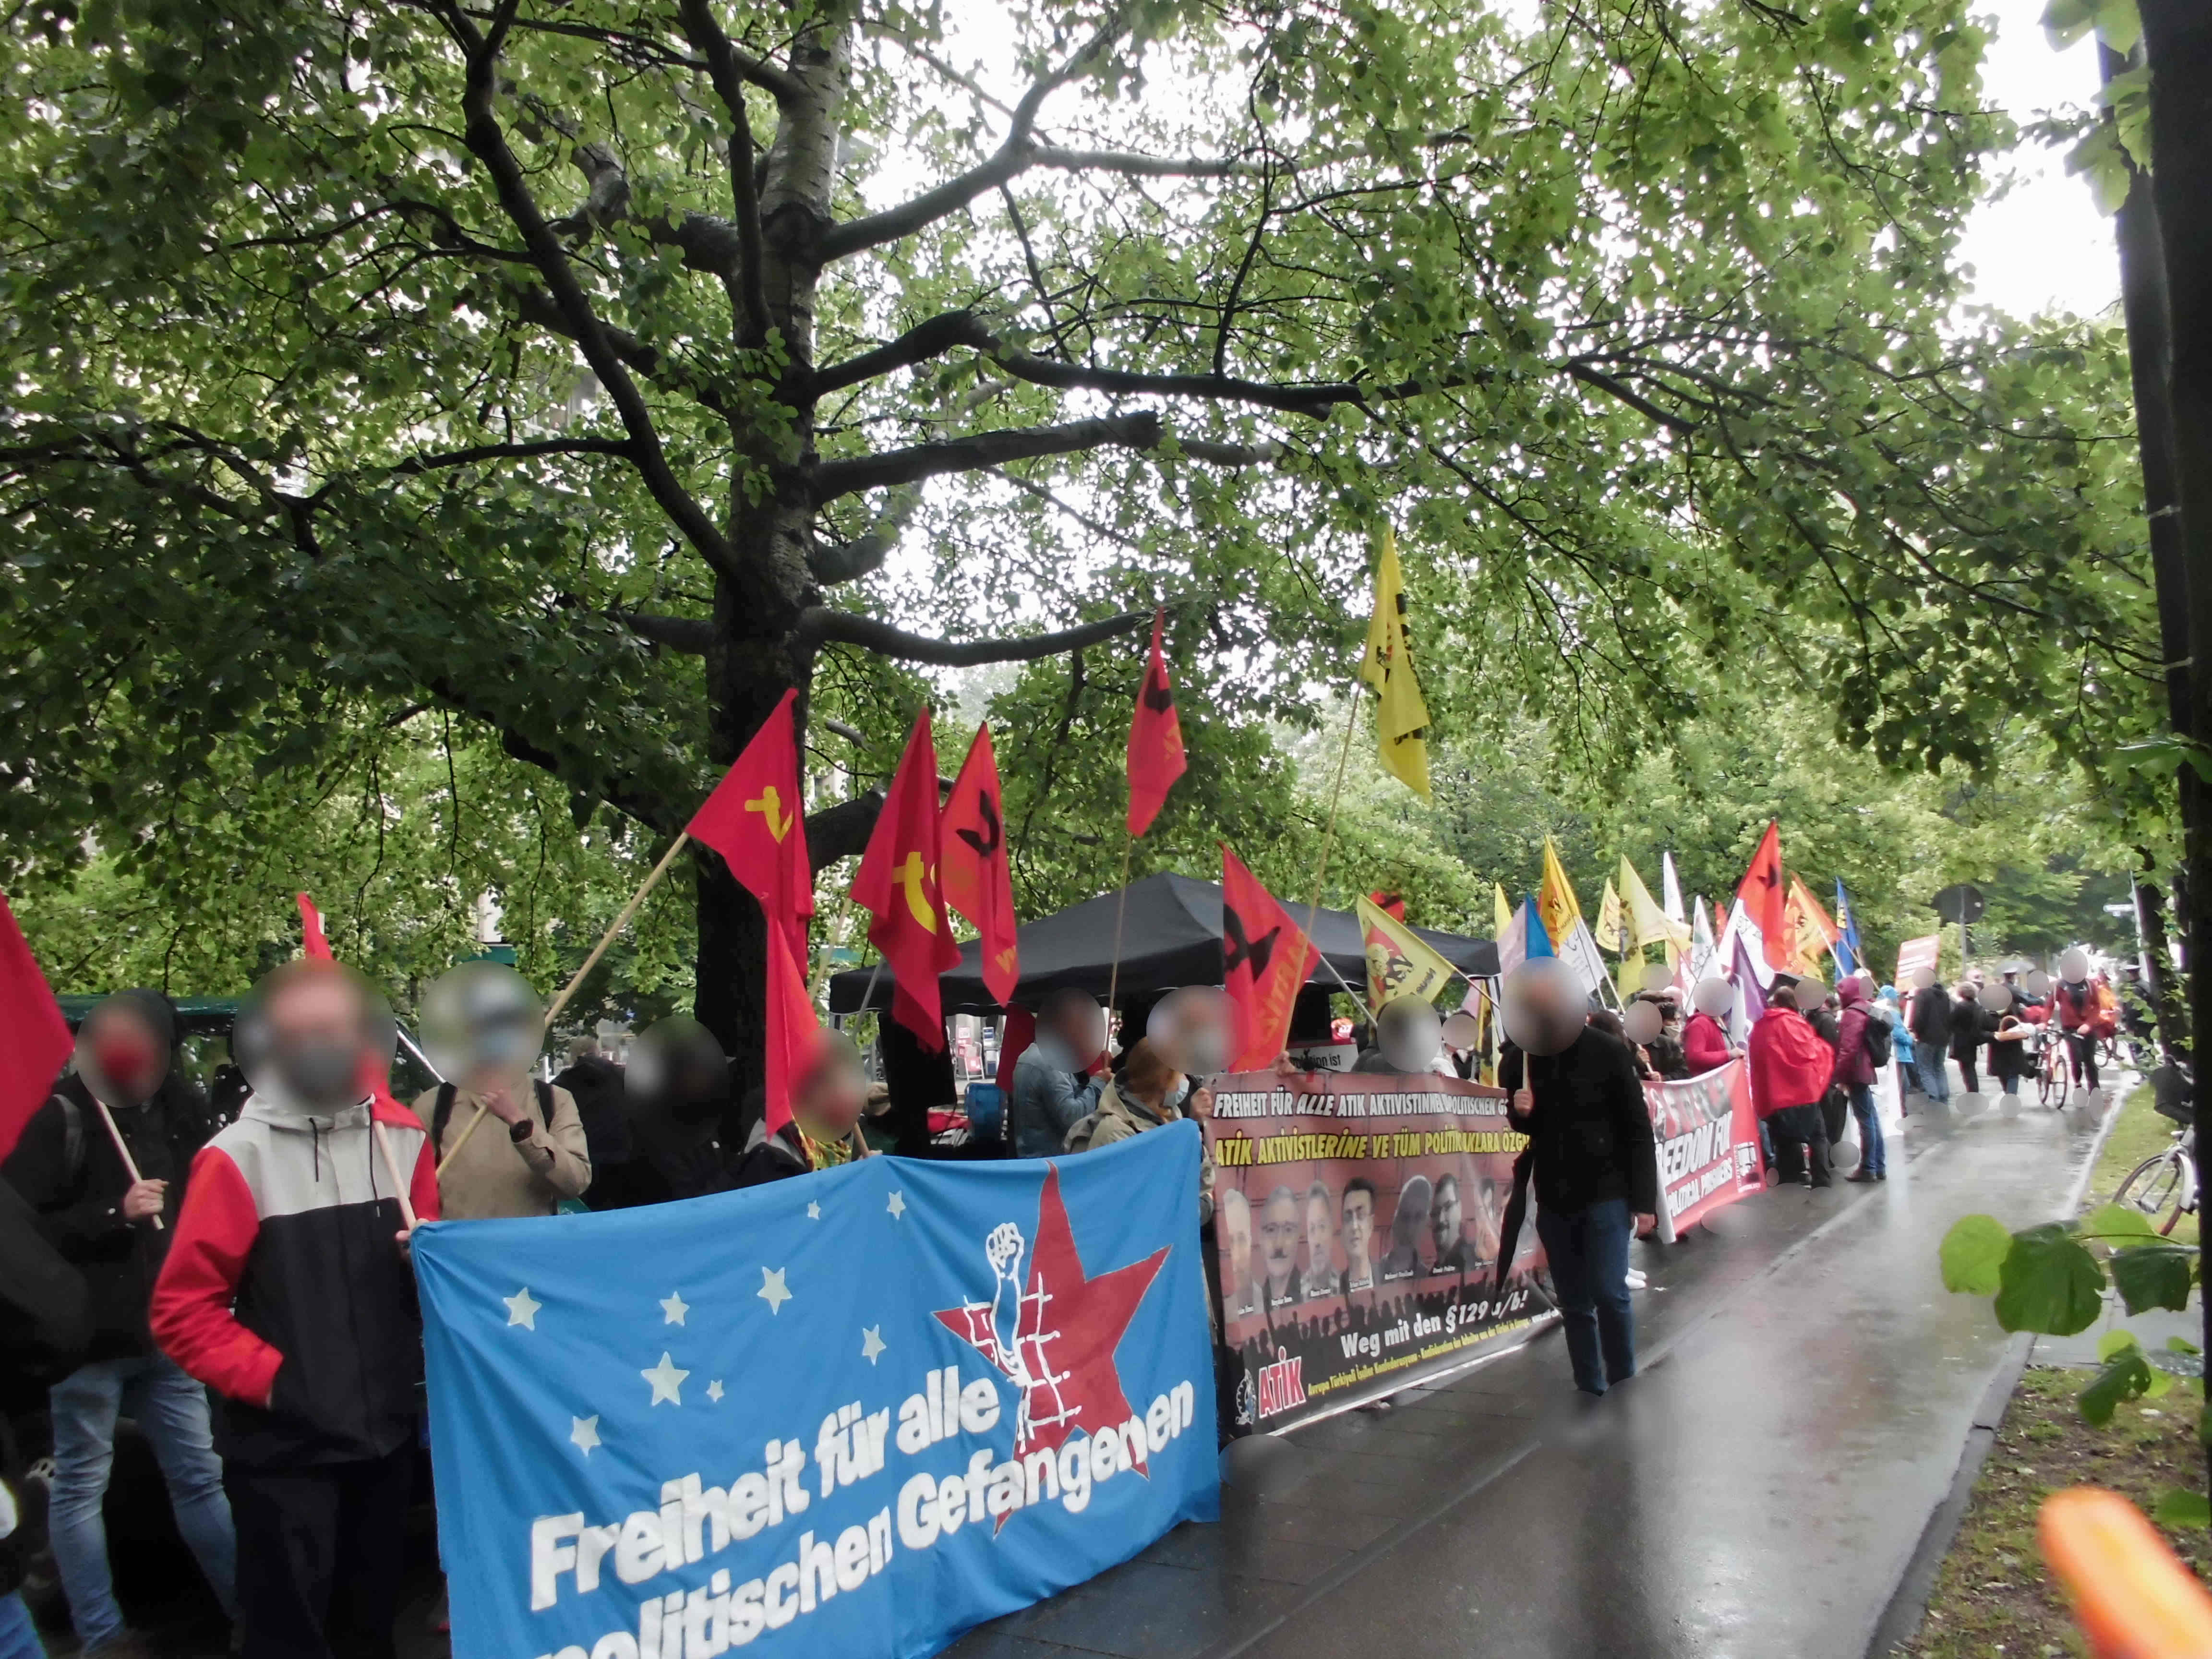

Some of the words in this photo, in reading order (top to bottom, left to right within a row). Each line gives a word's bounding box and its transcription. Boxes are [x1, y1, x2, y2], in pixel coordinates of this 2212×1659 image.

[1213, 1092, 1267, 1118] FREIHEIT
[1271, 1085, 1293, 1115] FÜR
[1297, 1093, 1334, 1116] ALLE
[1336, 1094, 1366, 1116] ATIK
[1372, 1134, 1390, 1158] VE
[1393, 1126, 1420, 1157] TÜM
[1340, 1332, 1380, 1358] Weg
[1384, 1319, 1409, 1346] mit
[1413, 1312, 1441, 1337] den
[531, 1437, 810, 1611] Freiheit
[815, 1400, 890, 1499] für
[896, 1365, 1000, 1455] alle
[533, 1505, 892, 1659] litischen
[897, 1379, 1194, 1550] Gefangenen
